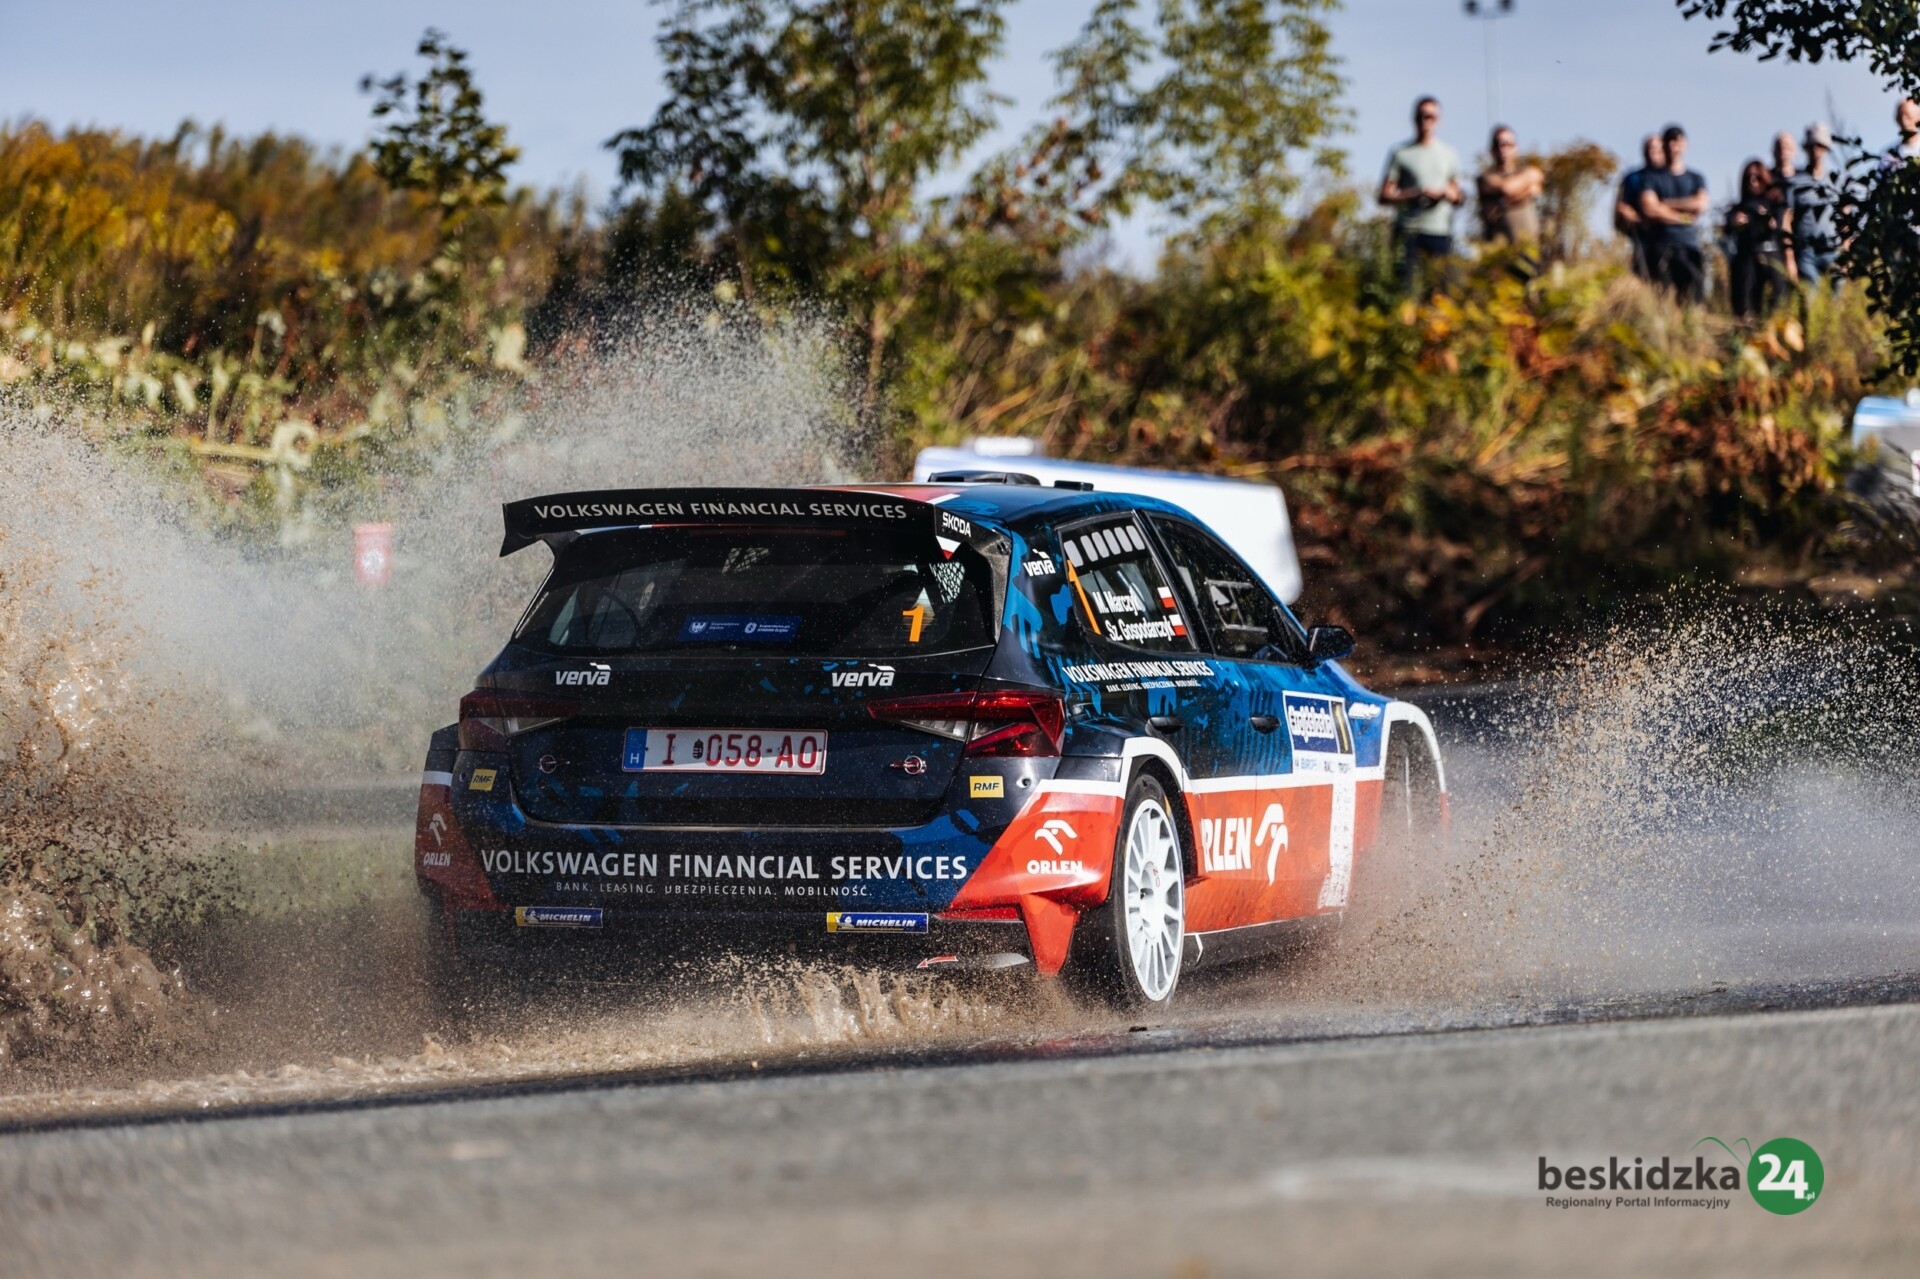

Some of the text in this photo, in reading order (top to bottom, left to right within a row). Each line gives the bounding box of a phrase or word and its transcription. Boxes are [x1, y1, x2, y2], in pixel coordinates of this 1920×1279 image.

[534, 502, 907, 519] VOLKSWAGEN FINANCIAL SERVICES
[1023, 558, 1056, 577] verva
[1092, 590, 1146, 617] M. Marczyk
[902, 604, 924, 642] 1
[1105, 616, 1176, 643] Sz. Gospodarczyk
[555, 668, 611, 686] verva
[832, 670, 894, 687] verva
[1062, 661, 1214, 683] VOLKSWAGEN FINANCIAL SERVICES
[662, 734, 676, 764] I
[630, 753, 639, 764] H
[473, 775, 492, 783] RMF
[973, 782, 1000, 791] RMF
[1199, 817, 1252, 872] RLEN
[423, 852, 451, 866] ORLEN
[481, 850, 968, 879] VOLKSWAGEN FINANCIAL SERVICES
[1026, 860, 1082, 874] ORLEN
[556, 882, 873, 896] BANK. LEASING. UBEZPIECZENIA. MOBILNOŚĆ.
[540, 913, 592, 922] MICHELIN
[855, 918, 917, 927] MICHELIN
